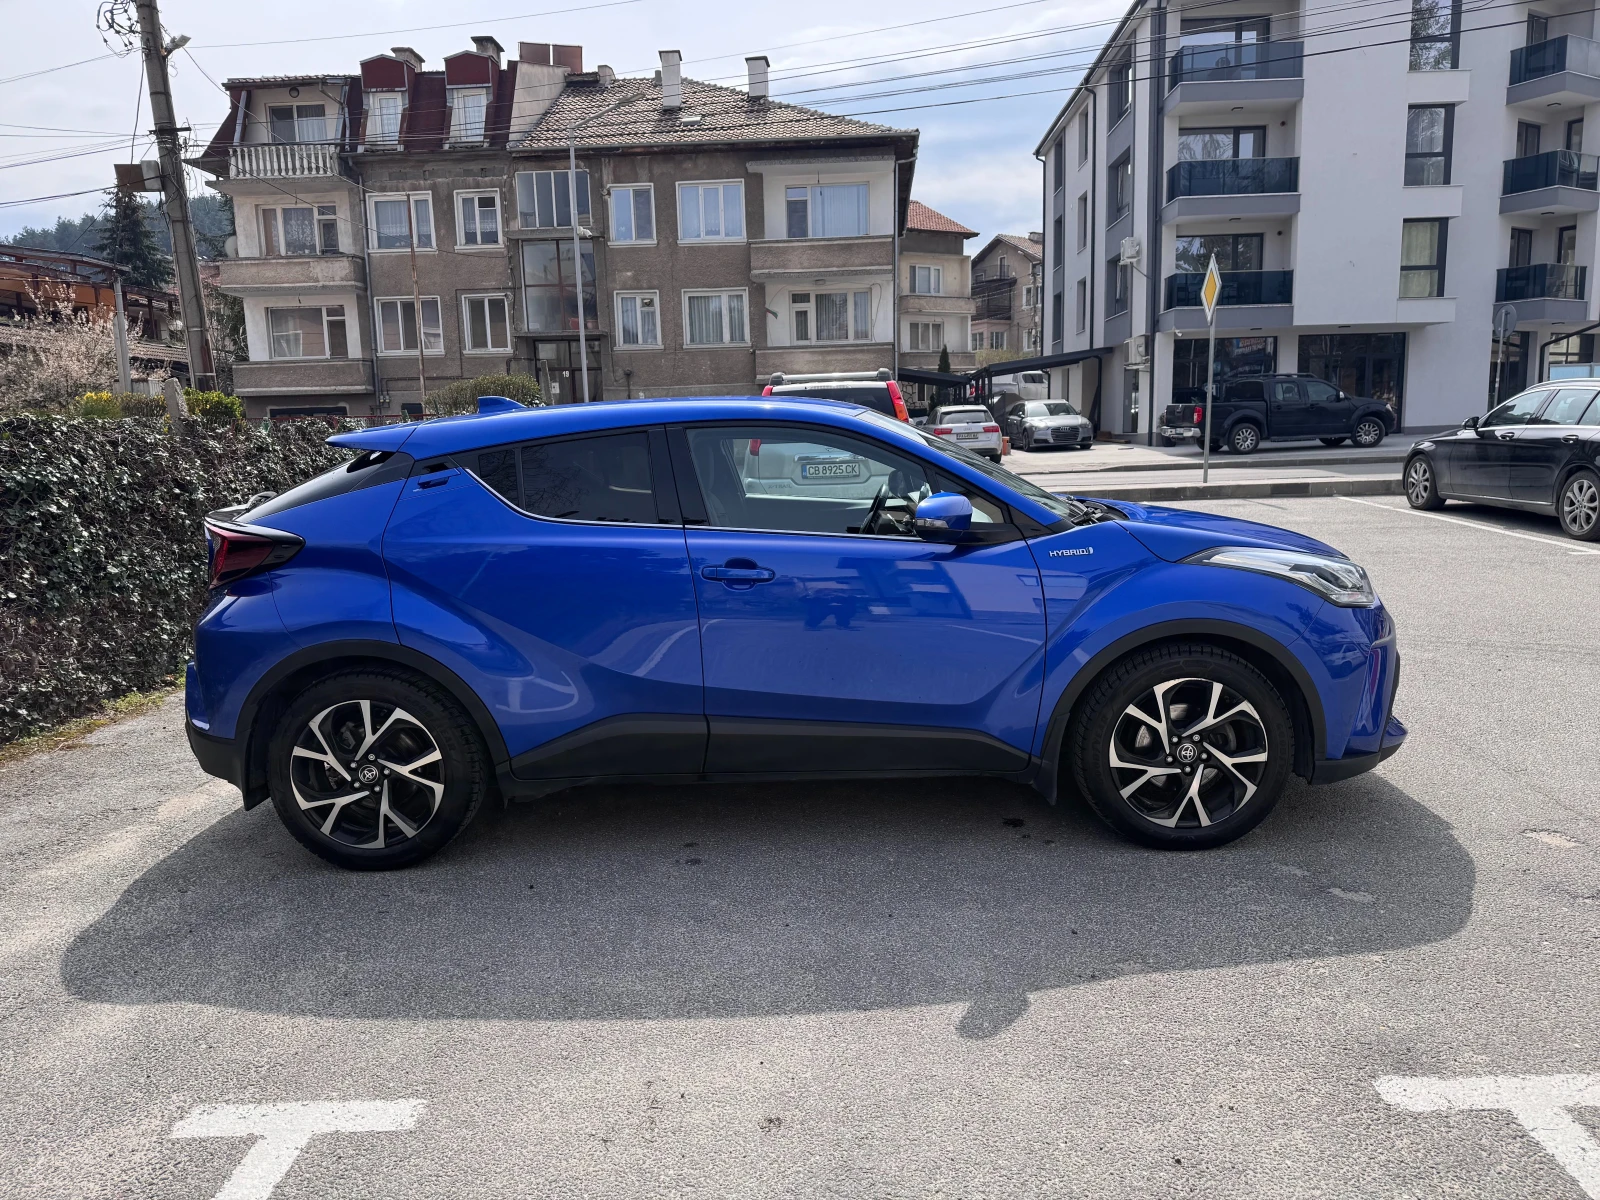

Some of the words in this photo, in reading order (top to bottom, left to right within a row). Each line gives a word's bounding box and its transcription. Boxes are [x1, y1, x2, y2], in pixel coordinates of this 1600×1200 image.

[807, 465, 820, 476] CB
[821, 464, 844, 475] 8925
[845, 463, 858, 474] CK
[1048, 548, 1087, 558] HYBRID
